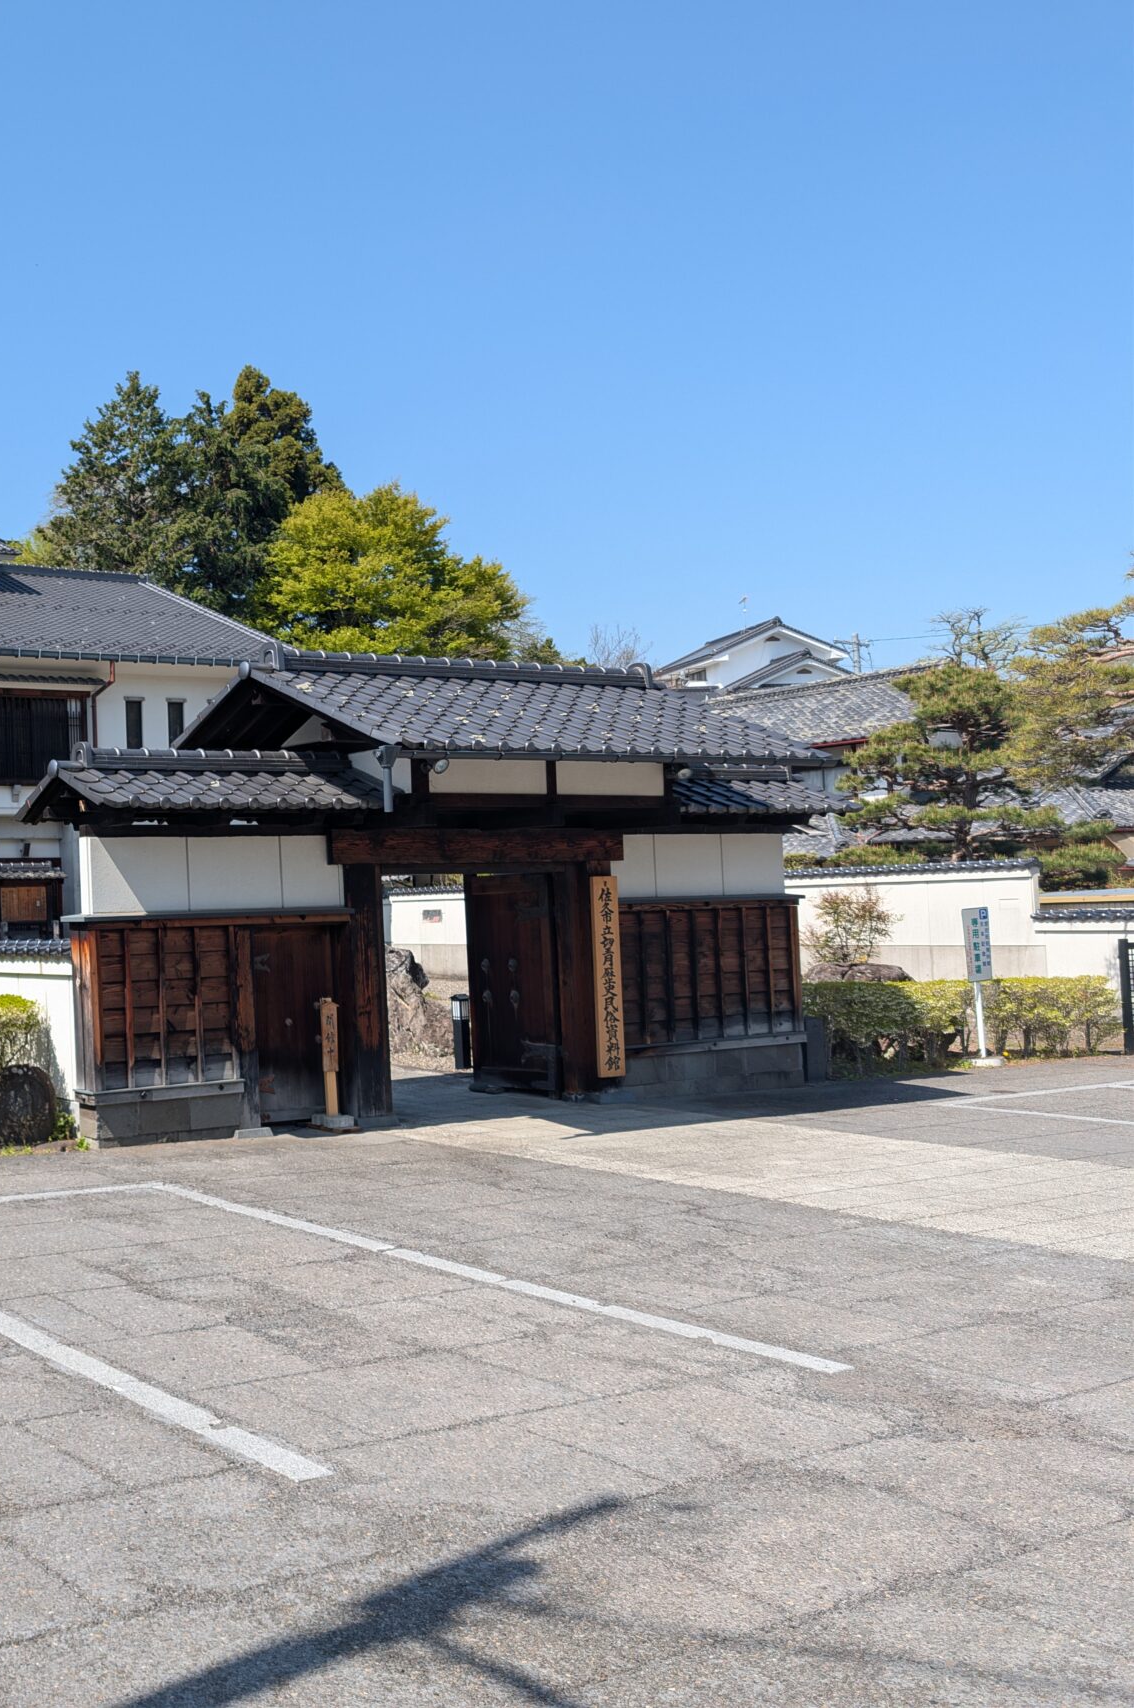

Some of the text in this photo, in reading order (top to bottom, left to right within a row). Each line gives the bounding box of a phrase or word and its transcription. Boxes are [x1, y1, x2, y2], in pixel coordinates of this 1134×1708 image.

[598, 888, 621, 1071] 佐久市立望月歴史民俗資料館
[971, 918, 982, 974] 専用駐車場
